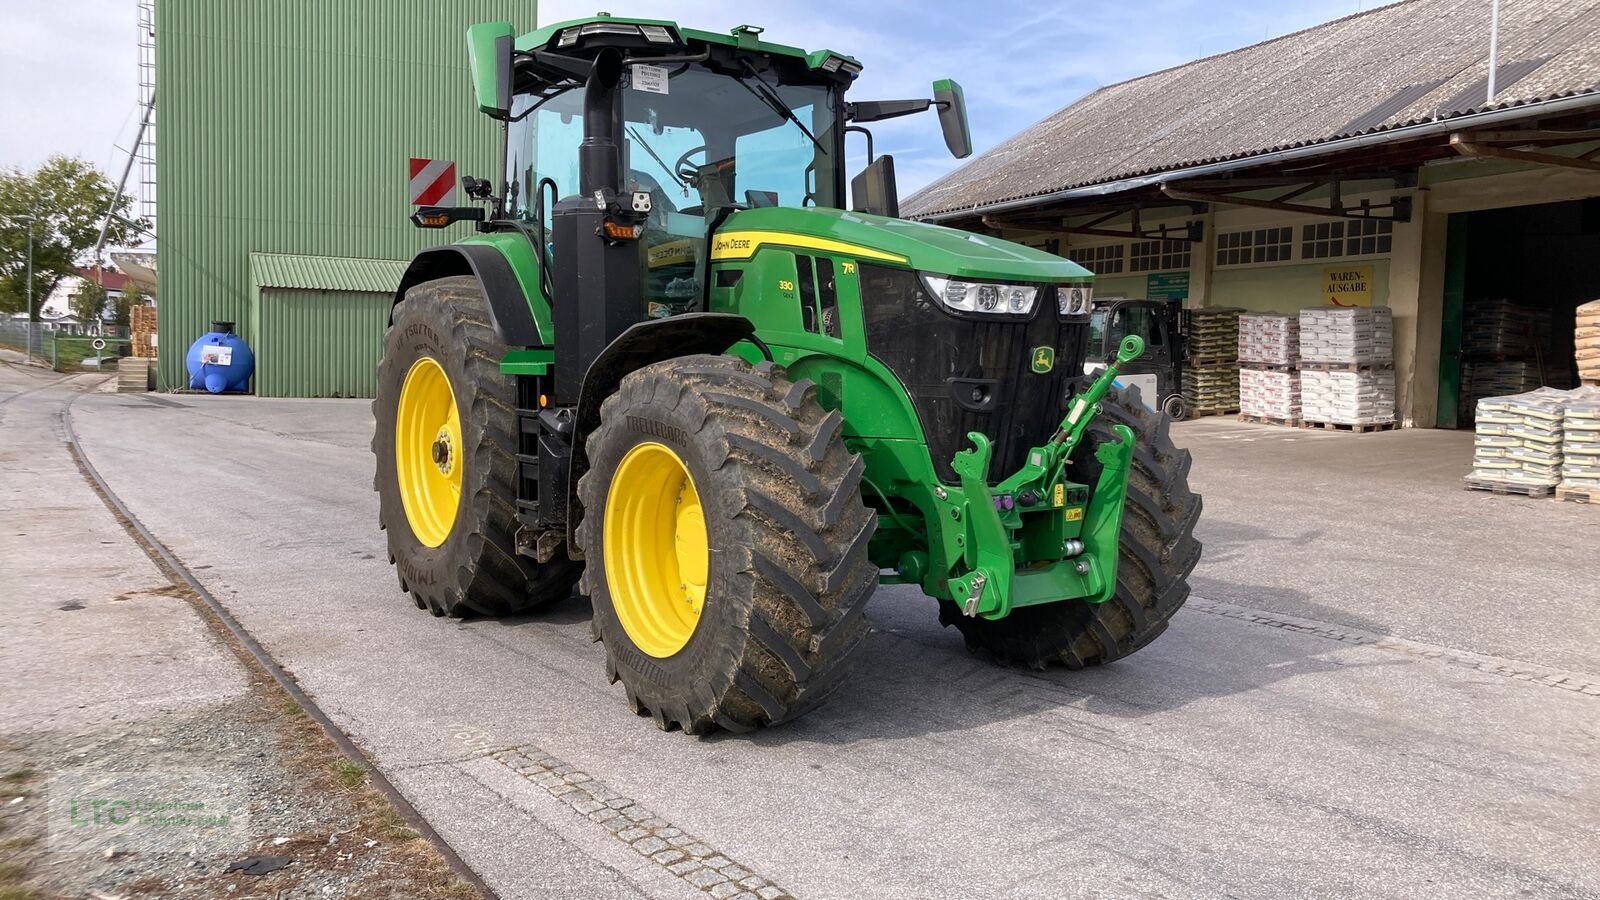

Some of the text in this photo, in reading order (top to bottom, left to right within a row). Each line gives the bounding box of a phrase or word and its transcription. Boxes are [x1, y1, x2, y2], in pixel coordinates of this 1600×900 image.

[715, 238, 750, 251] JOHN DEERE
[841, 262, 855, 275] 7R
[1330, 271, 1365, 281] WAREN-
[779, 280, 794, 291] 330
[1327, 282, 1367, 293] AUSGABE
[626, 415, 688, 448] TRELLEBORG
